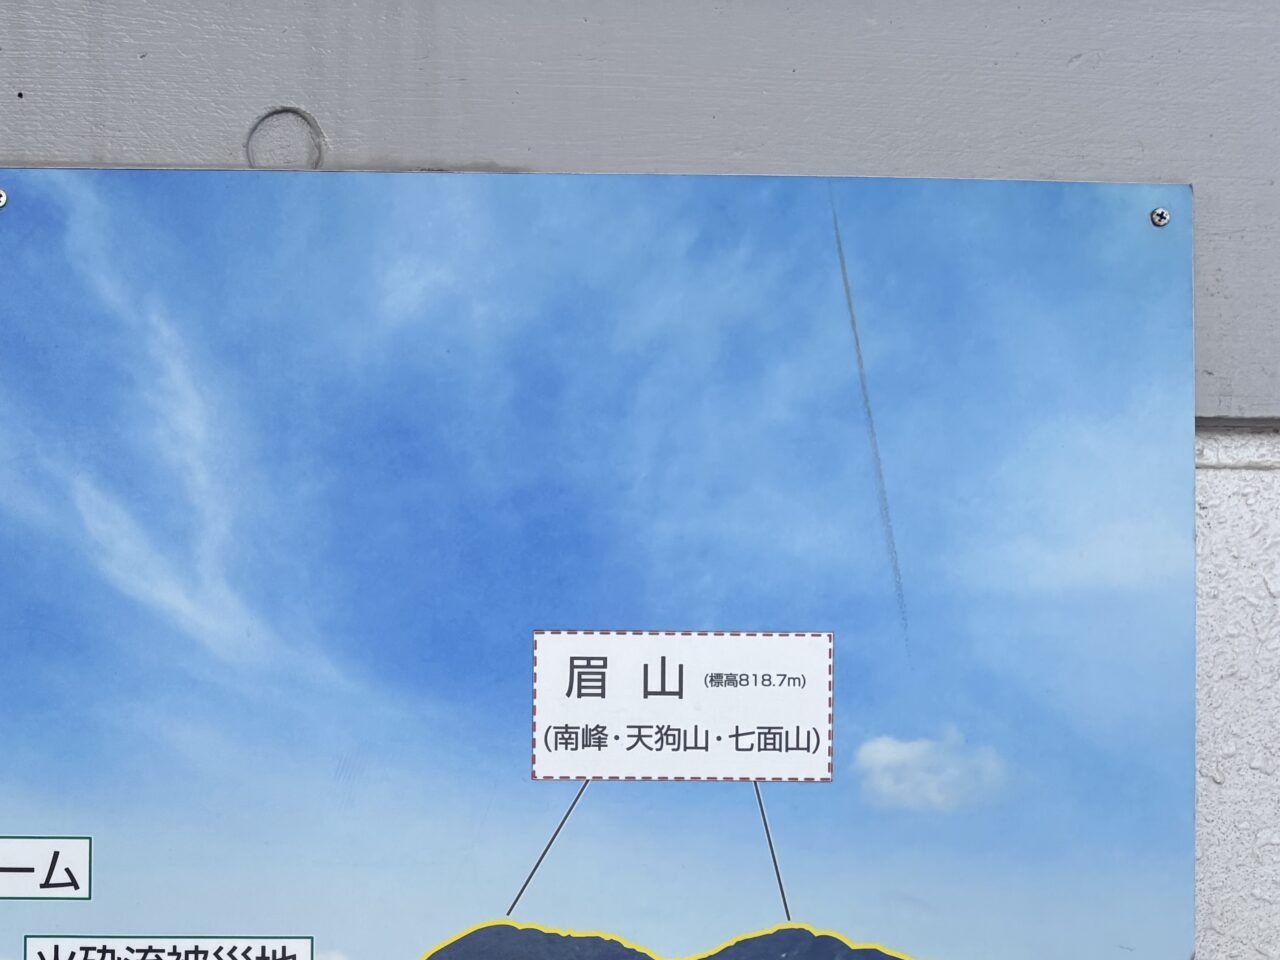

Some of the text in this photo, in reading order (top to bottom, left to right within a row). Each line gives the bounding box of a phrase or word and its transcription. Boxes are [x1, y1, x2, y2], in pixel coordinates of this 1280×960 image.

[704, 672, 807, 689] (標高818.7m)
[543, 723, 821, 754] (南峰・天狗山・七面山)
